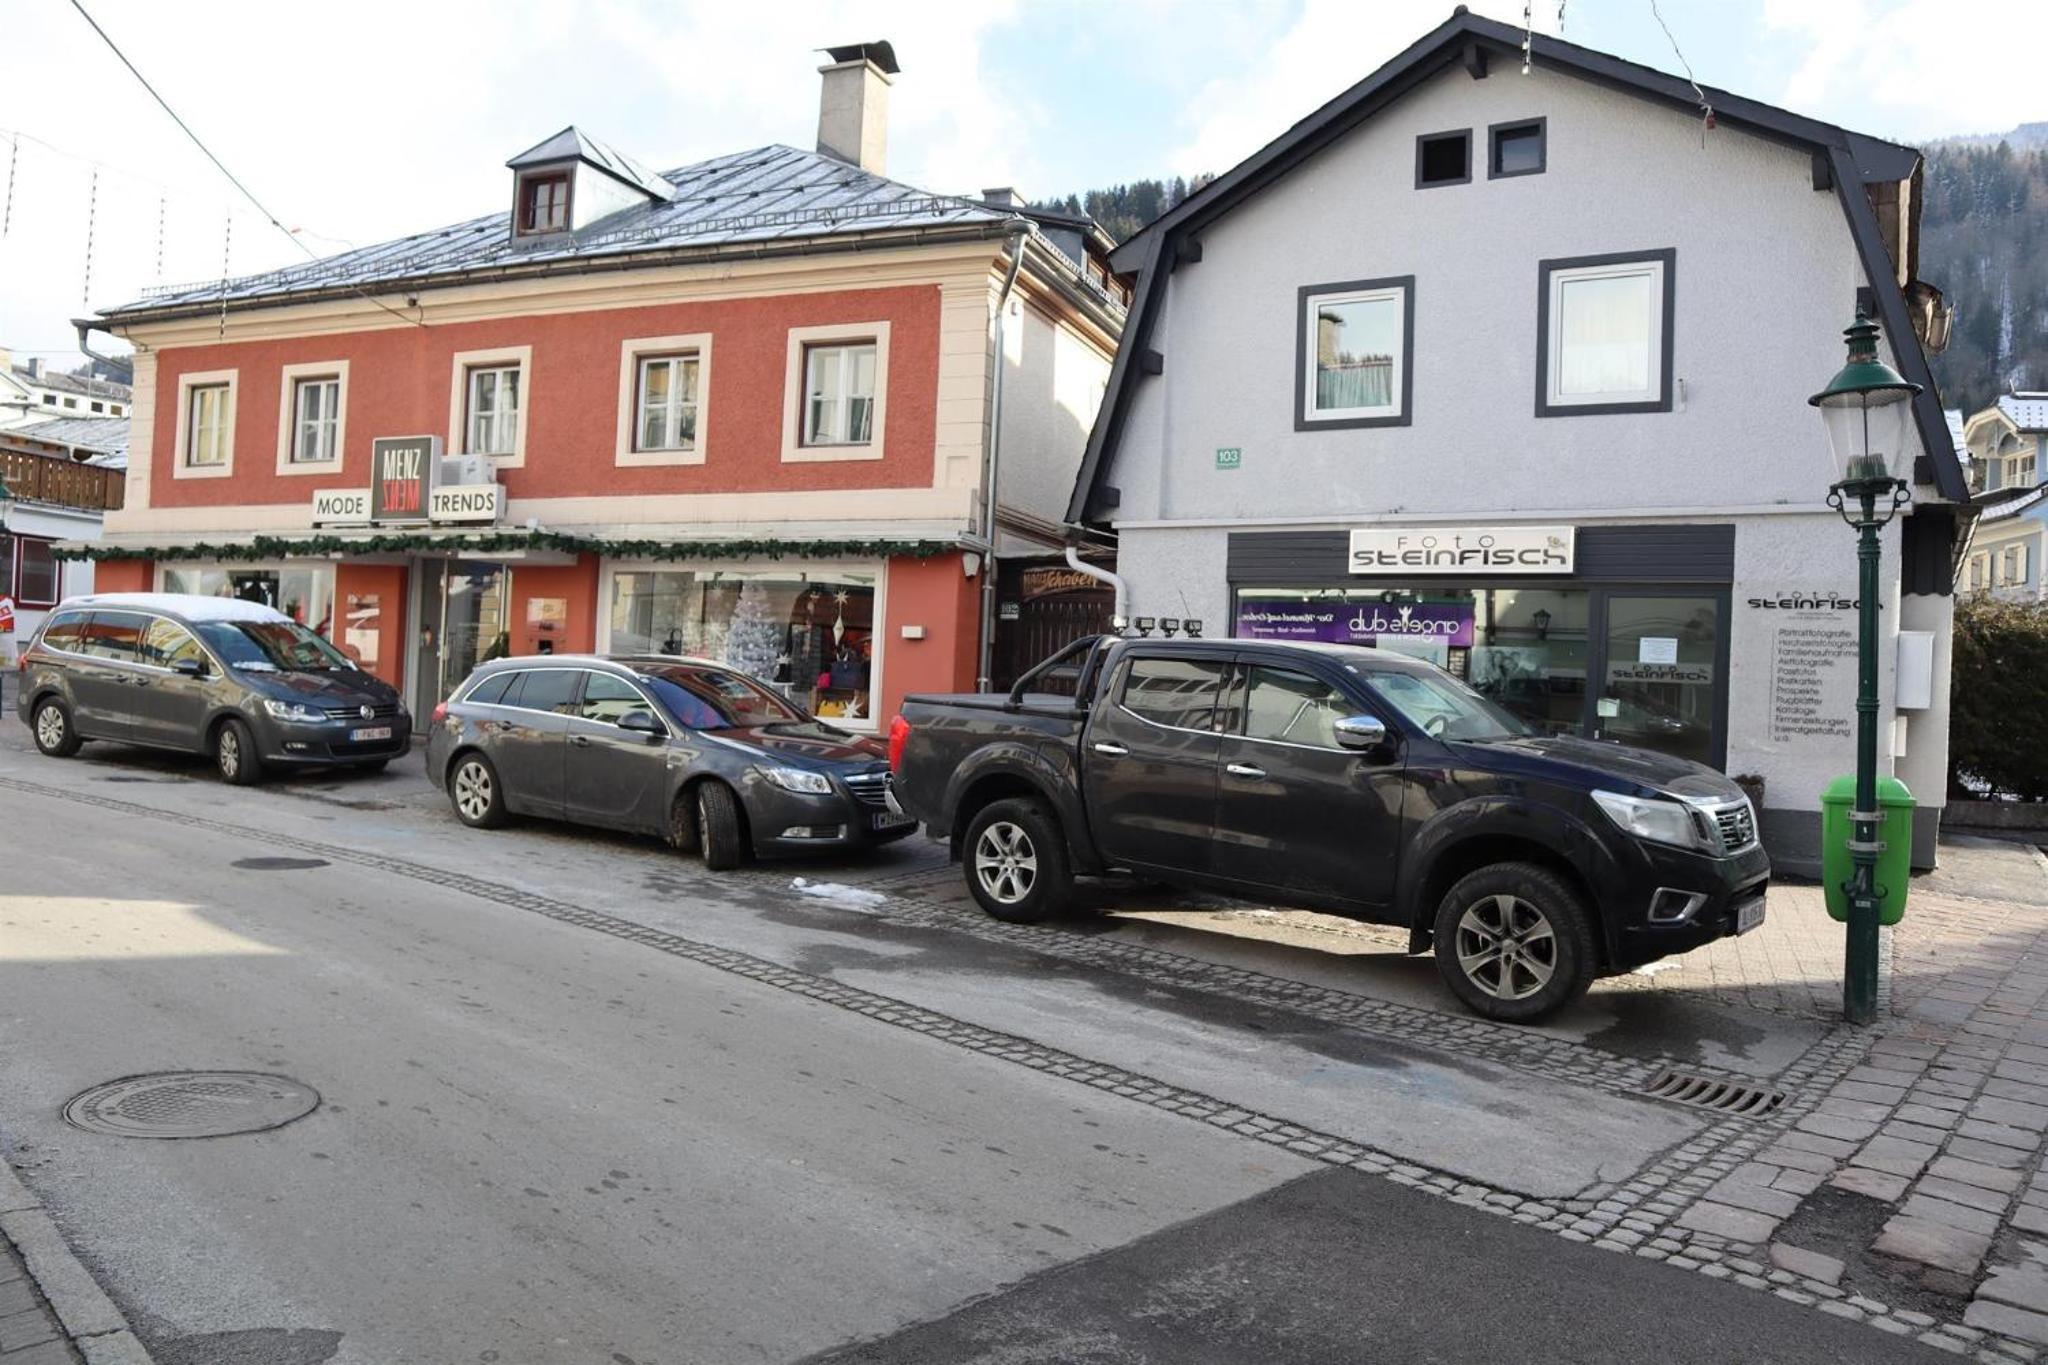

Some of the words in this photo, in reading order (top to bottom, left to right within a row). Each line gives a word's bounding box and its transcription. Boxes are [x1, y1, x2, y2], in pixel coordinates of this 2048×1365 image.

[383, 449, 421, 480] MENZ
[1219, 450, 1238, 463] 103
[317, 497, 363, 514] MODE
[433, 493, 495, 512] TRENDS
